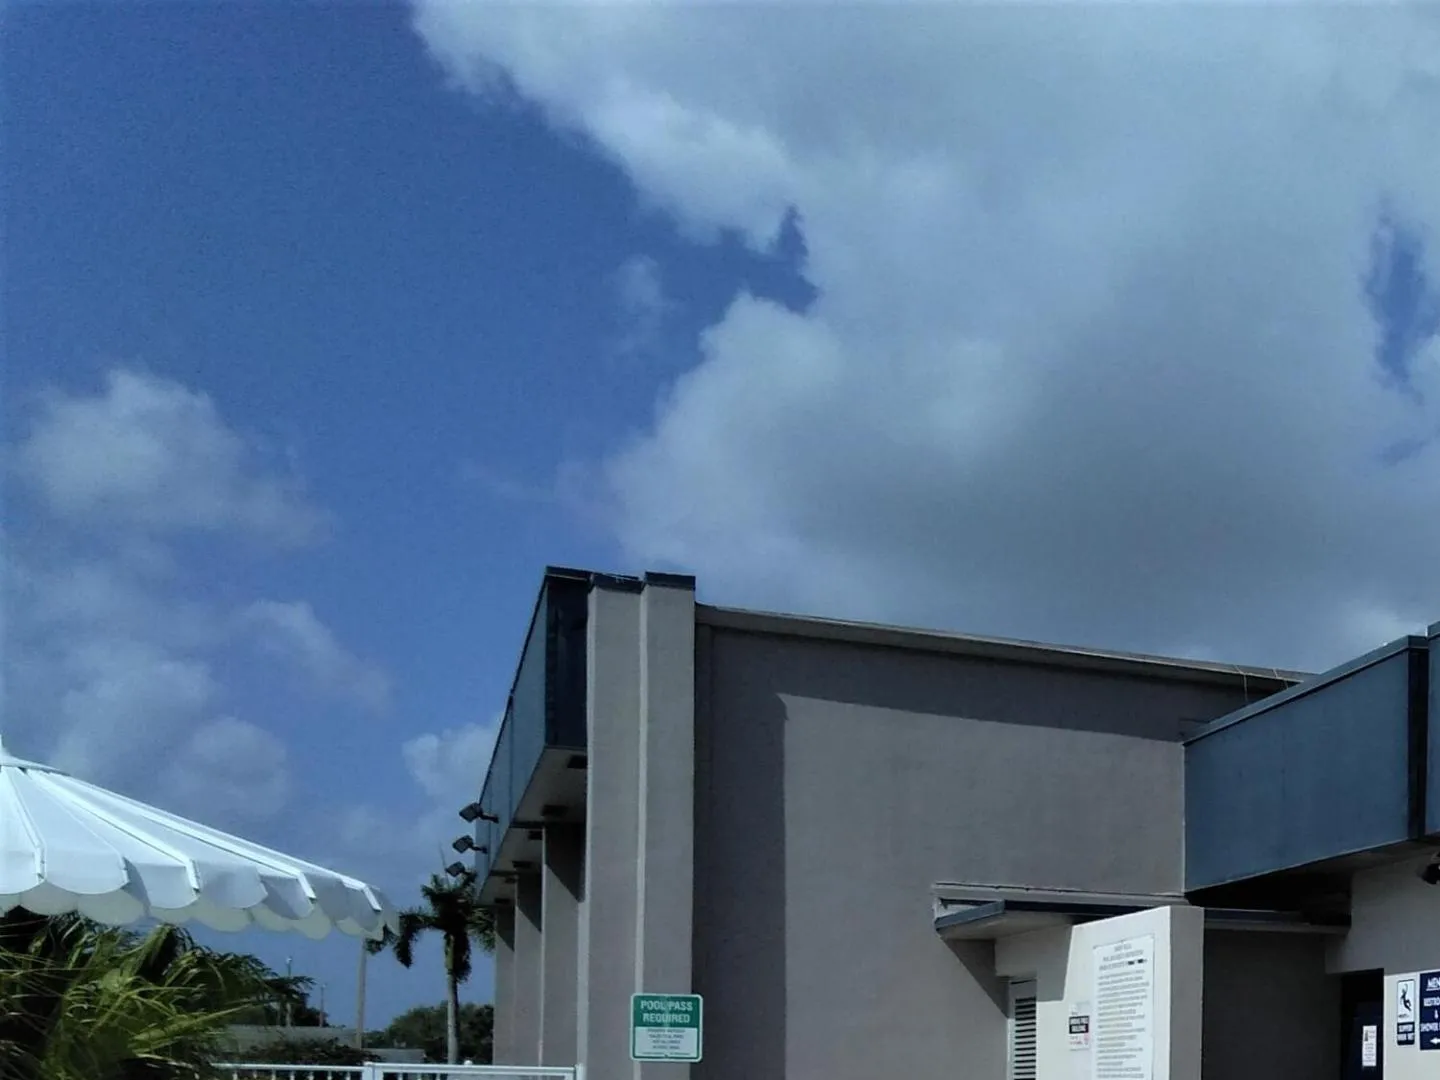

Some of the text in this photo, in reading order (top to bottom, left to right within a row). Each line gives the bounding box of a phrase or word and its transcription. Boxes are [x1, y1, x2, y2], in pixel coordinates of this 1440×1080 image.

[640, 1000, 693, 1011] POOL PASS
[643, 1013, 690, 1024] REQUIRED
